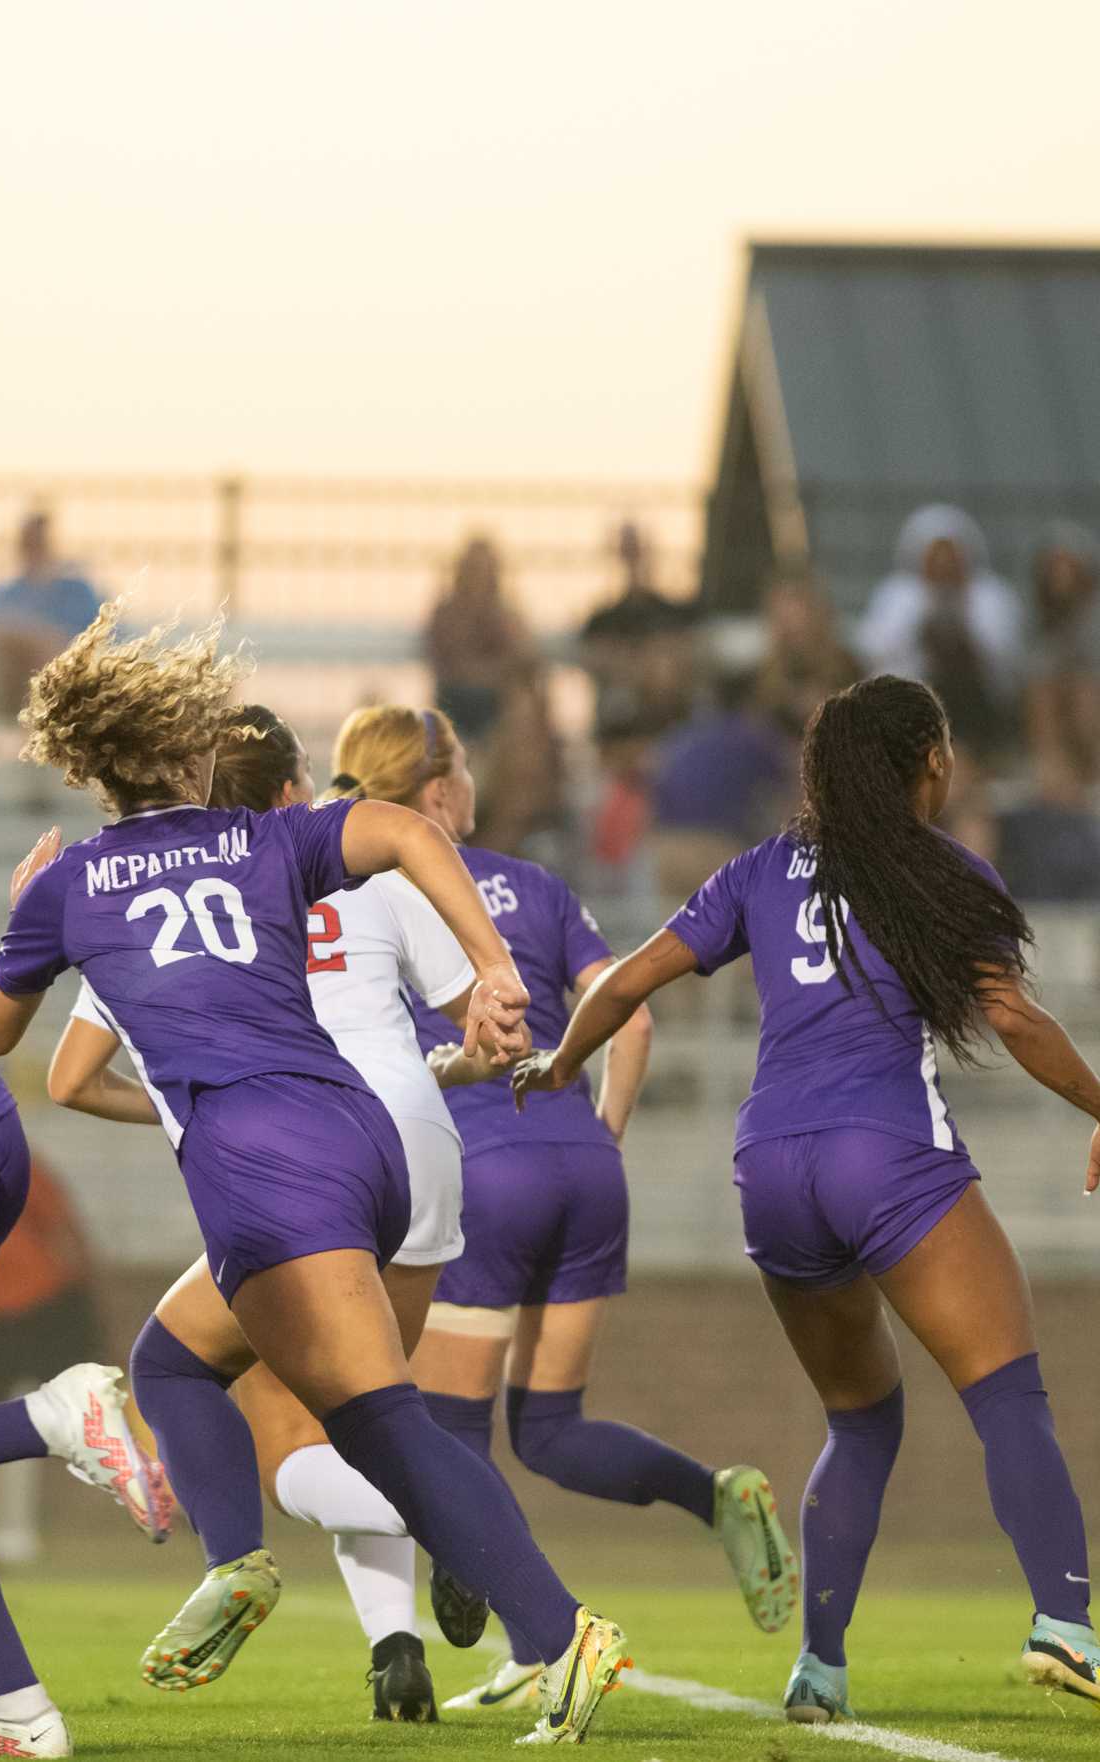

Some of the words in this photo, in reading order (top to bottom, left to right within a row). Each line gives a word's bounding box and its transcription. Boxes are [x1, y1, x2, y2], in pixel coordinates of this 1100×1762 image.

[126, 877, 258, 968] 20
[477, 873, 519, 917] GS
[791, 892, 850, 985] 9
